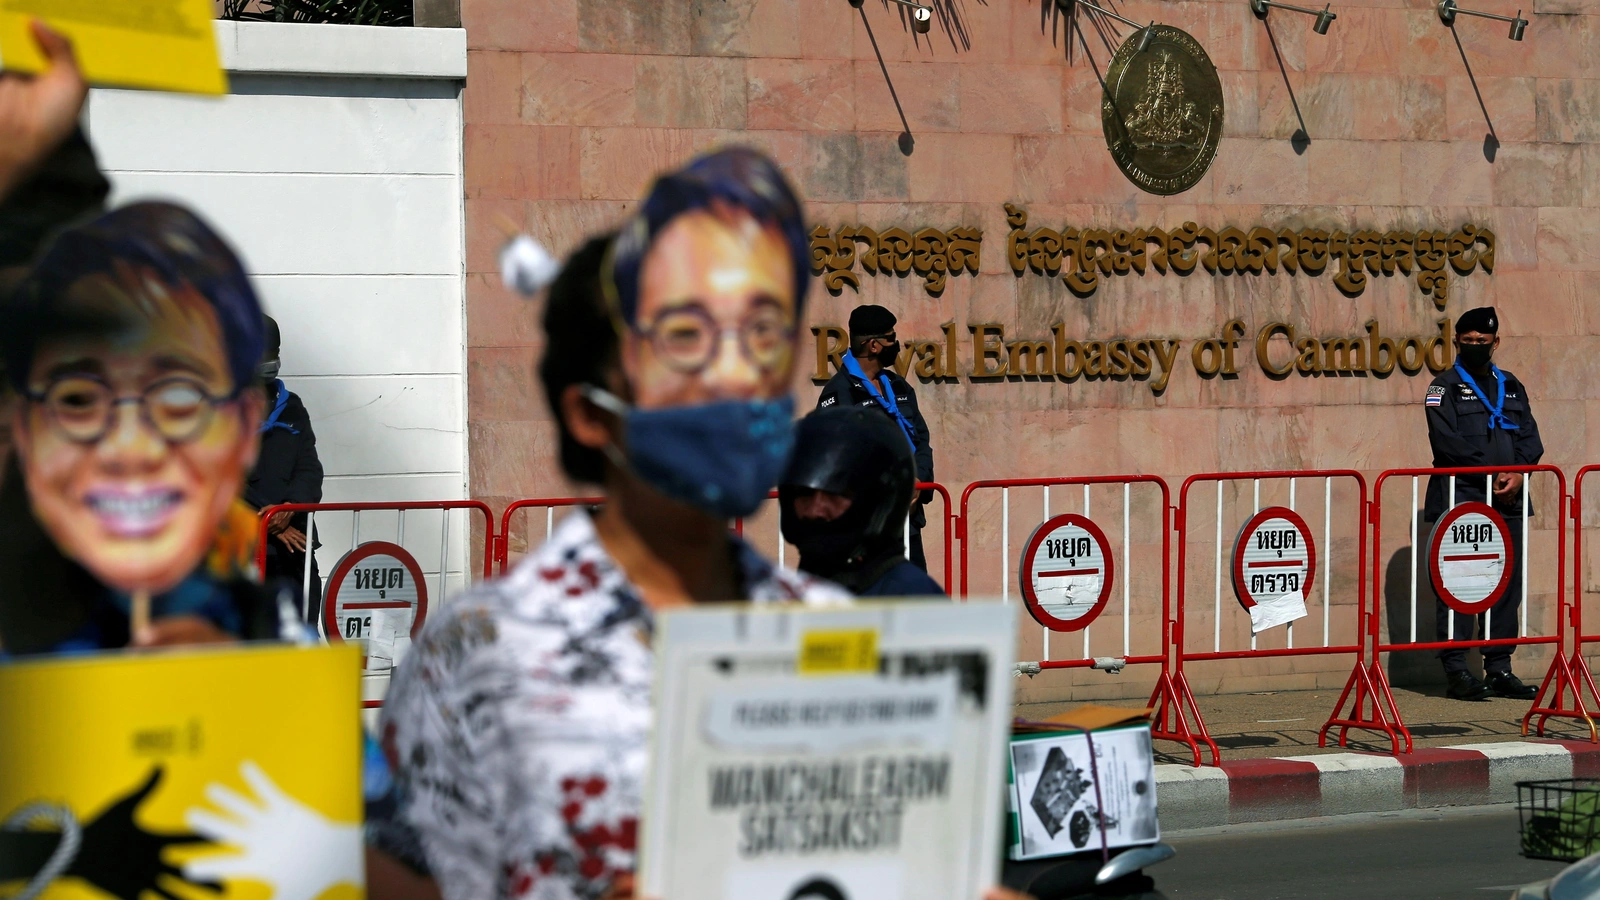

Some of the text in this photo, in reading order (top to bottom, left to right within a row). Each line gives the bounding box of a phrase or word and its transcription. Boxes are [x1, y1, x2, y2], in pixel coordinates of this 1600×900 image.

[810, 319, 1451, 391] Ryal Embassy of Cambod
[821, 397, 835, 408] POLICE
[1428, 385, 1446, 395] POLICE
[1255, 530, 1296, 558] หยุด
[1450, 523, 1492, 551] หยุด
[1046, 537, 1091, 567] หยุด
[354, 568, 404, 599] หยุด
[1251, 573, 1299, 593] ตรวจ
